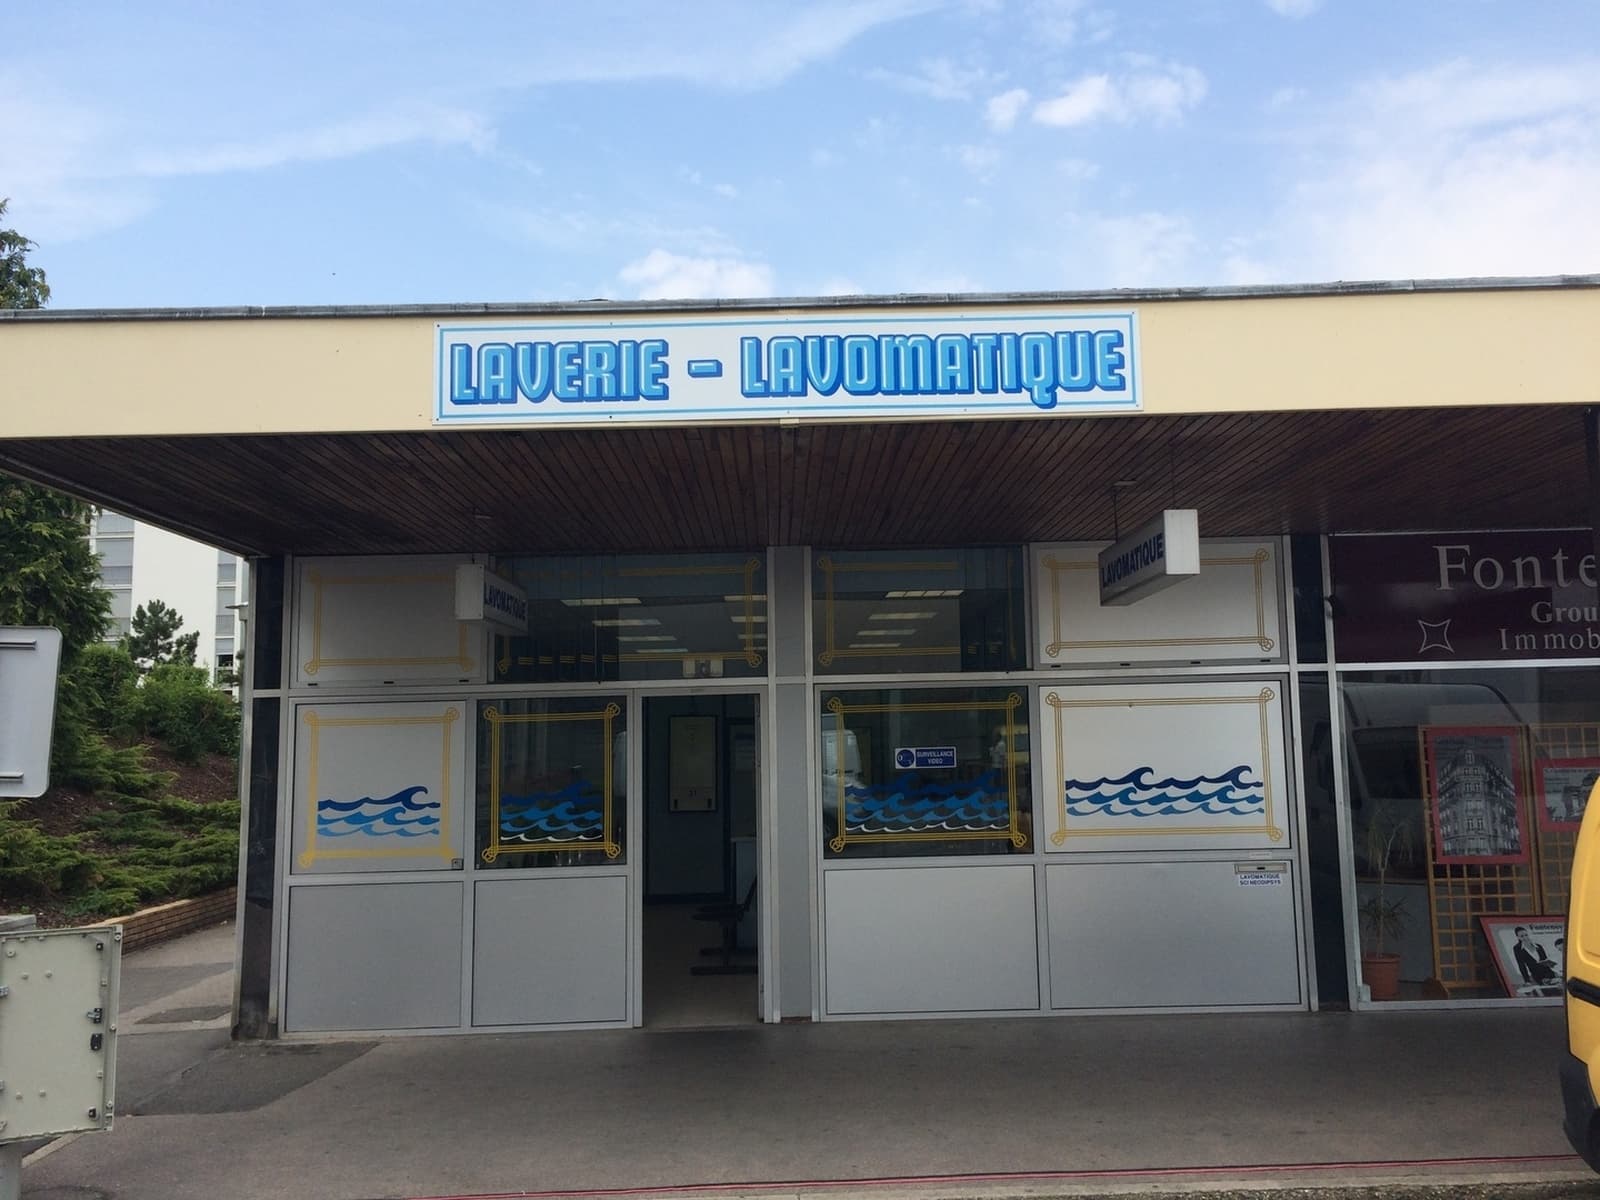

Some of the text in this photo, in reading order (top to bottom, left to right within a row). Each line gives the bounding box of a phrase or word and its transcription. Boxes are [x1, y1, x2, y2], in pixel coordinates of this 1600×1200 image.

[451, 330, 1124, 408] LAVERIE - LAVOMATIQUE
[1101, 532, 1165, 588] LAVOMATIQUE
[1432, 544, 1598, 591] Fonte
[1530, 601, 1600, 623] Grou
[1500, 628, 1600, 651] Immob
[916, 750, 954, 758] SURVEILLANCE
